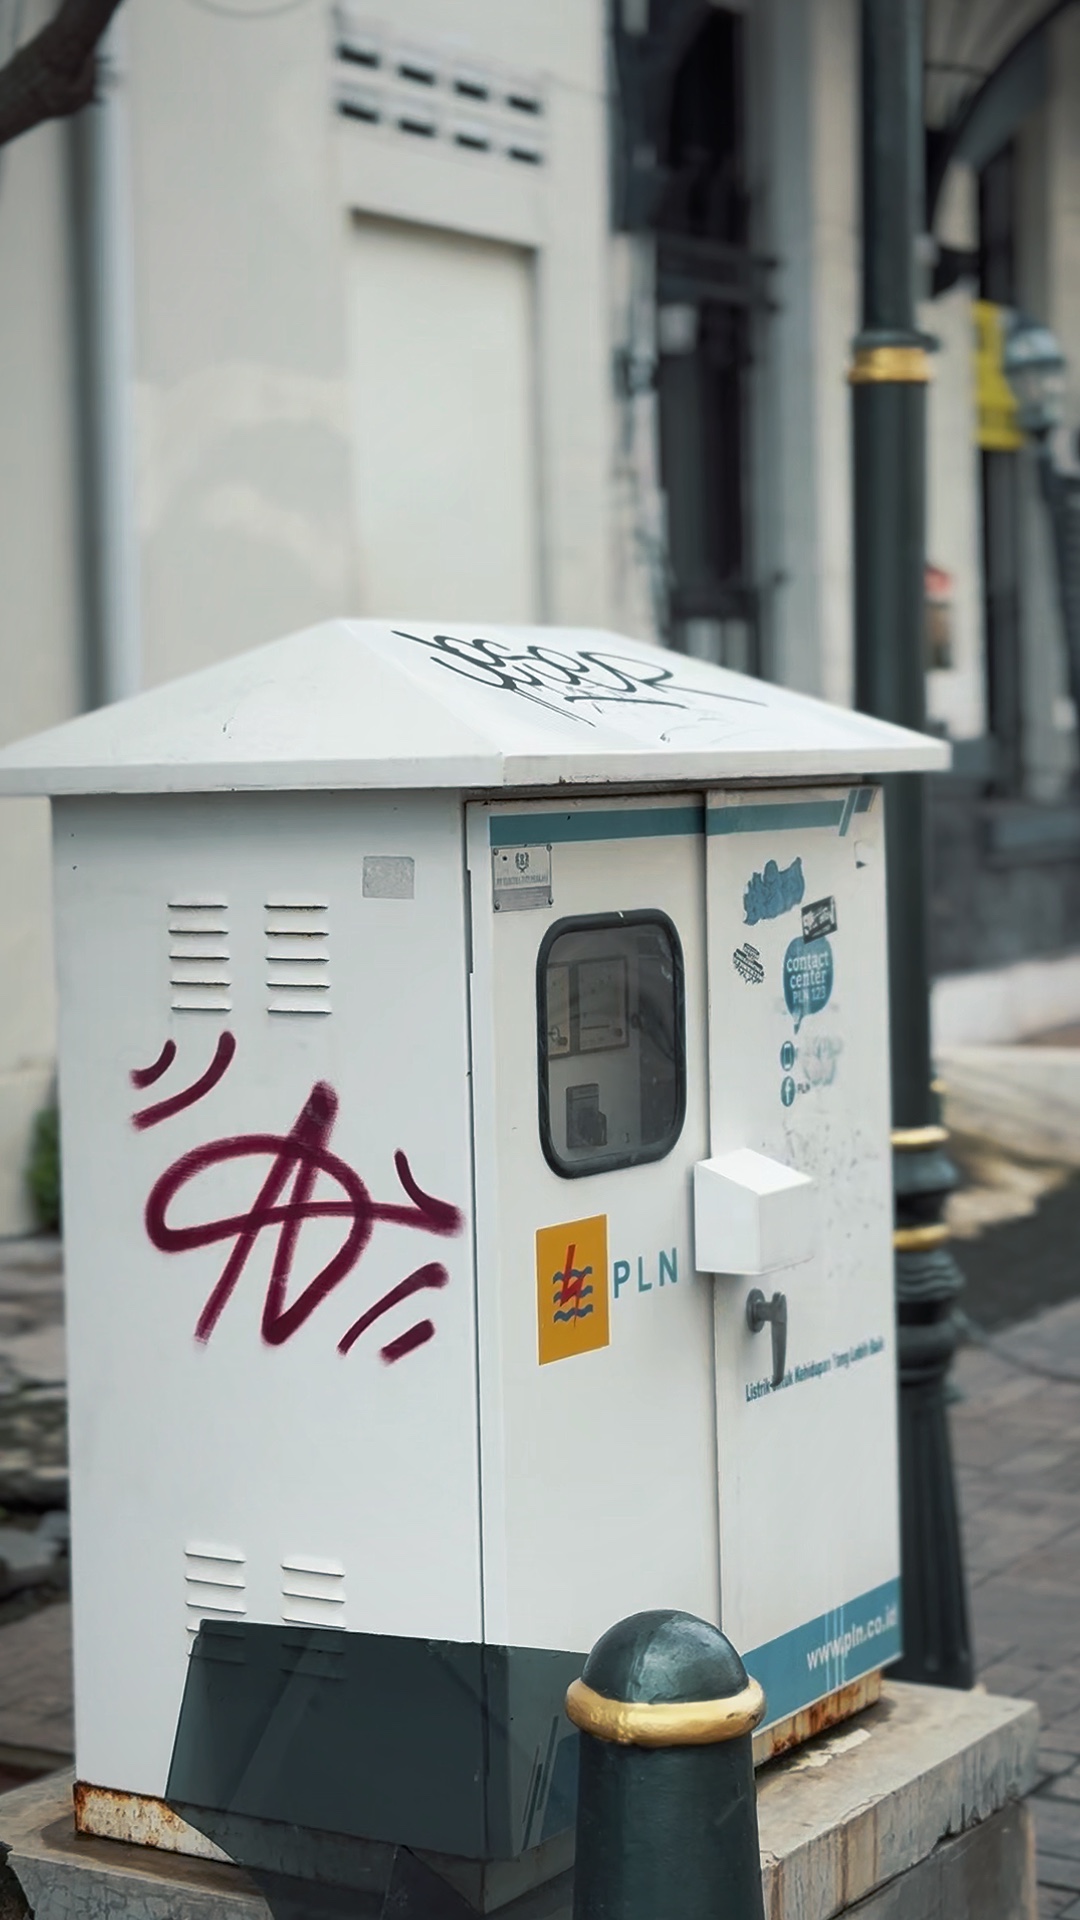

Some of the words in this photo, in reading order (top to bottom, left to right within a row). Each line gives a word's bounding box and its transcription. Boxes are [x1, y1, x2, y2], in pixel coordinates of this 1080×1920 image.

[786, 951, 829, 972] contact
[789, 970, 826, 989] center
[793, 989, 809, 1004] PLN
[811, 986, 826, 1001] 123
[613, 1247, 678, 1299] PLN
[745, 1377, 770, 1402] Listrik
